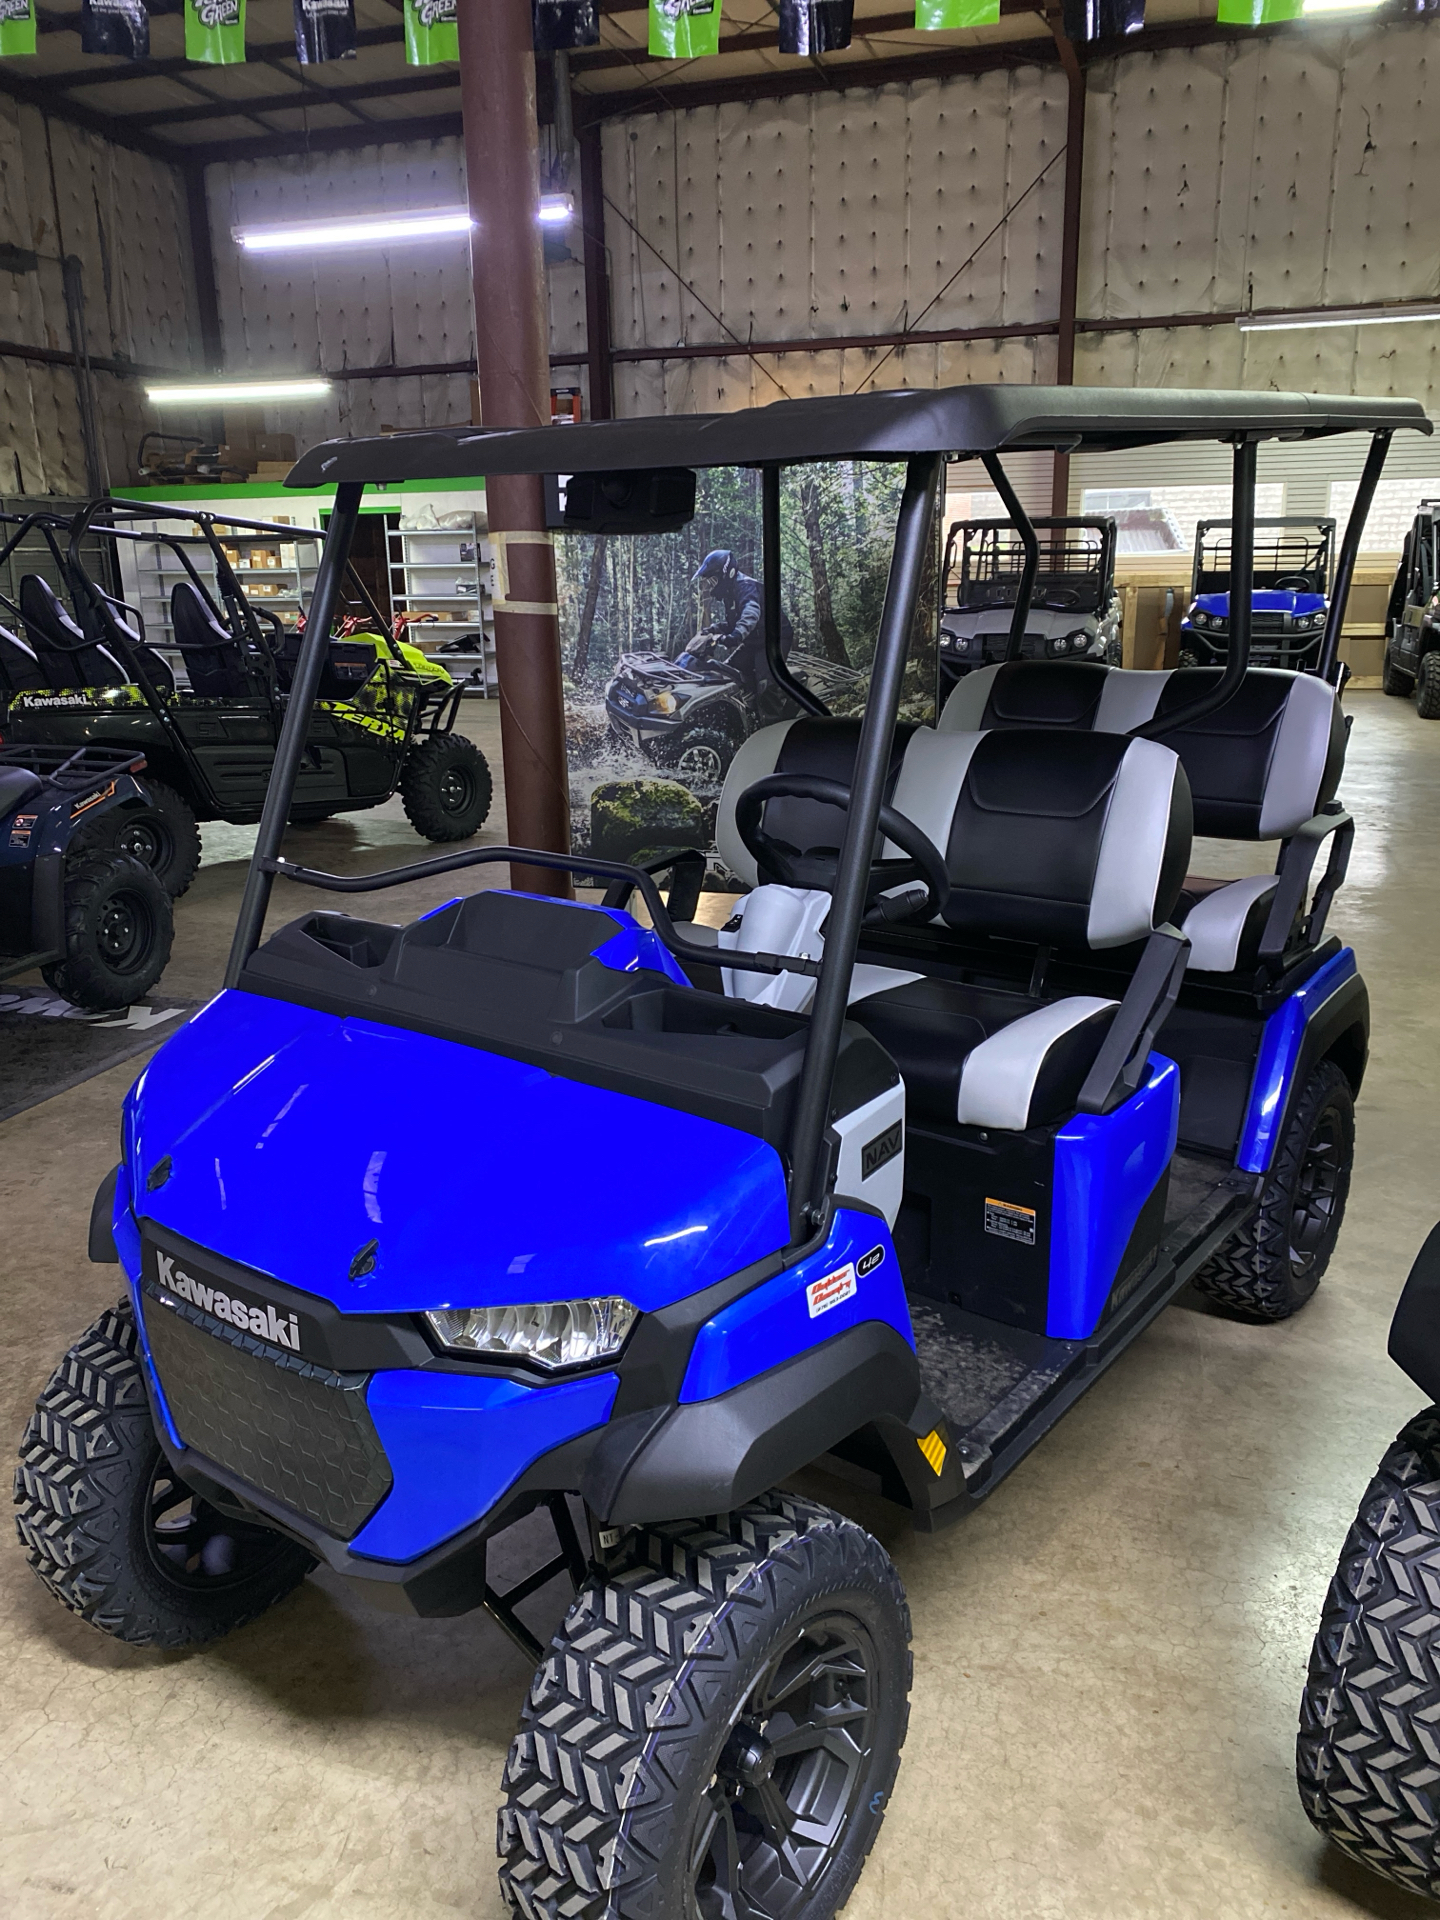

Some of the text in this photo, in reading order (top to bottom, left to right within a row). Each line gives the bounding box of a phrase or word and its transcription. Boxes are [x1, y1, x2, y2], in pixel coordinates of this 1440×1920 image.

[201, 0, 238, 25] GREEN
[23, 694, 86, 707] Kawasaki
[74, 791, 101, 810] Kawasaki
[866, 1130, 899, 1169] NAV
[157, 1250, 300, 1351] Kawasaki
